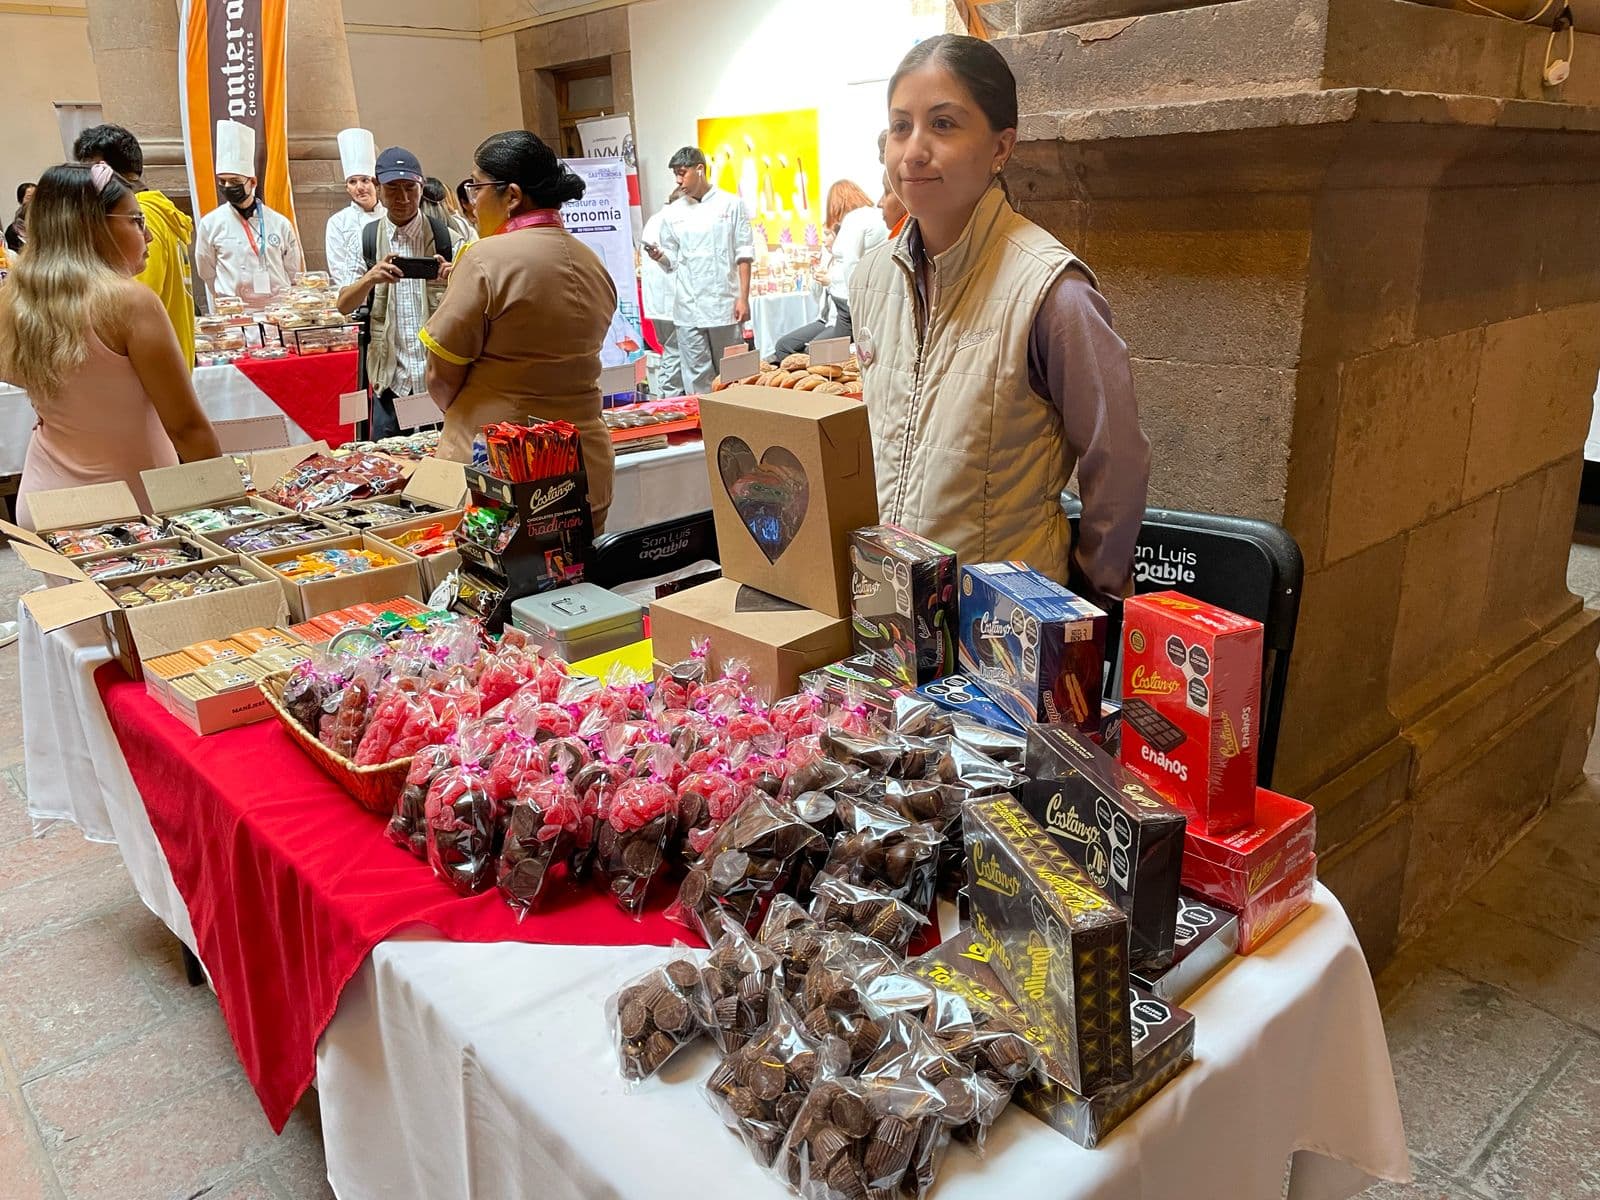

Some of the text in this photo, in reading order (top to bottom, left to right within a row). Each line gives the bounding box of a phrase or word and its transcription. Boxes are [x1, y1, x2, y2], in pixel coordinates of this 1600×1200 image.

[246, 32, 257, 116] CHOCOLATES
[563, 207, 622, 223] ronomía
[599, 198, 610, 206] en
[530, 479, 576, 515] Costanzo
[642, 528, 691, 548] San Luis
[1134, 544, 1197, 565] an Luis
[851, 571, 882, 600] Costanzo
[980, 611, 1013, 640] Costanzo
[1131, 665, 1180, 695] Costanzo
[1219, 710, 1240, 758] Costanzo
[1241, 706, 1251, 748] enanos
[1140, 745, 1188, 782] enanos
[1045, 793, 1101, 844] Costanzo
[973, 840, 1020, 897] Costanzo
